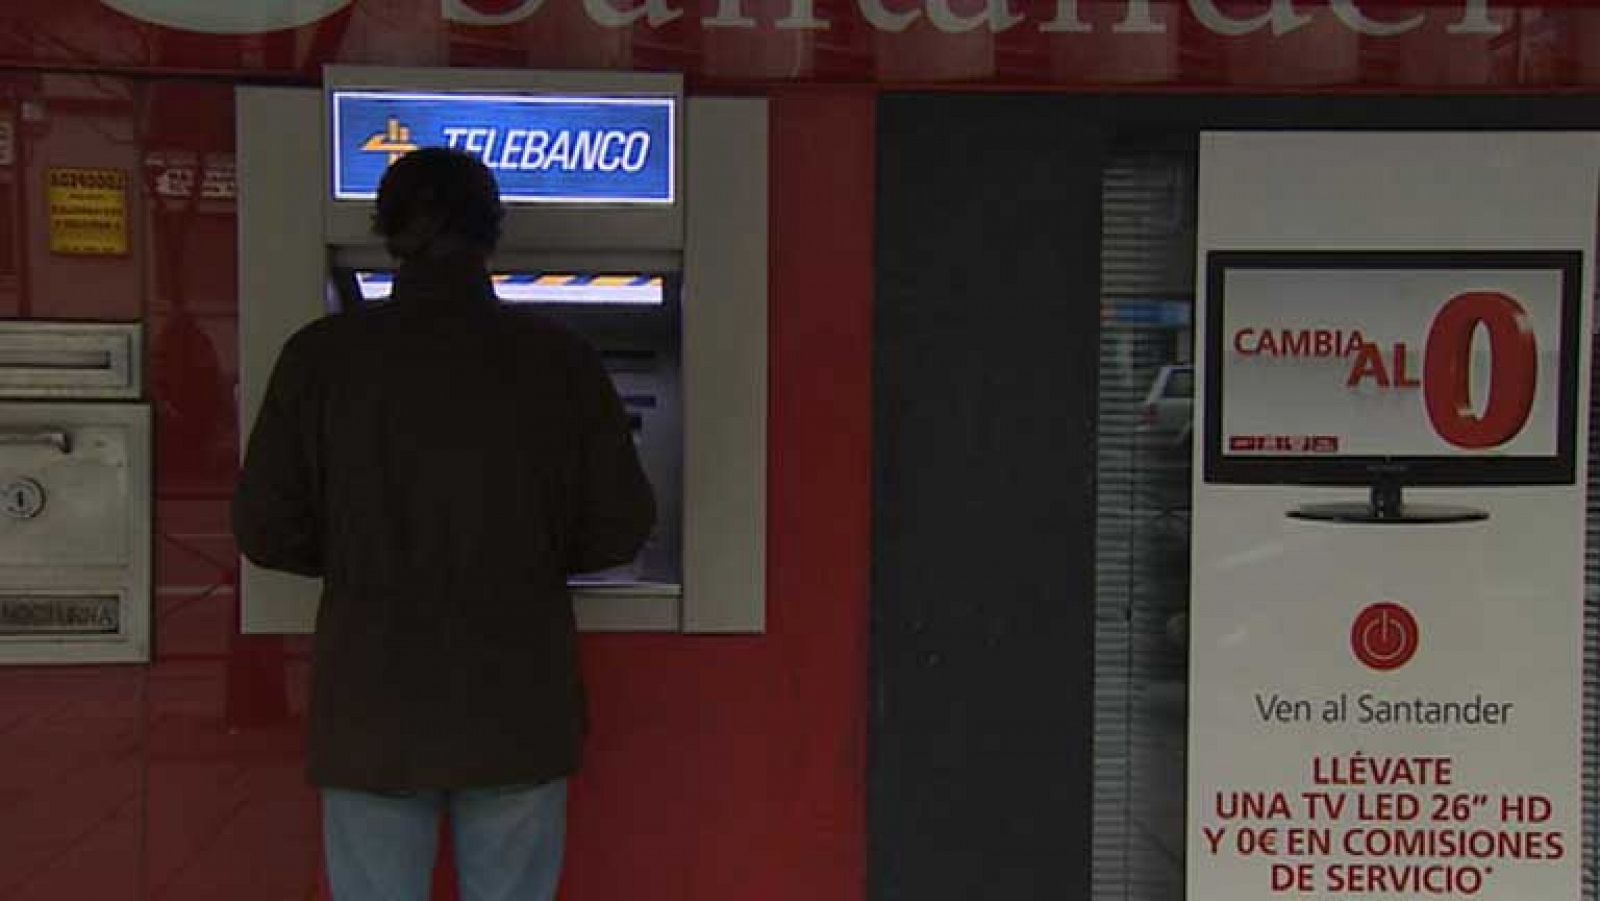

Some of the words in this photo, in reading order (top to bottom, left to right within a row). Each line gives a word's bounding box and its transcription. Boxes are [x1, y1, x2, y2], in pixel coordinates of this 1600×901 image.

[443, 126, 651, 173] TELEBANCO
[1234, 329, 1365, 357] CAMBIA
[1347, 343, 1421, 388] AL
[1424, 291, 1538, 449] 0
[1255, 695, 1311, 722] Ven
[1322, 695, 1347, 723] al
[1358, 695, 1512, 724] Santander
[1313, 751, 1452, 785] LLÉVATE
[1216, 793, 1290, 820] UNA
[1303, 793, 1346, 820] TV
[1358, 794, 1419, 820] LED
[1501, 797, 1551, 822] HD
[1203, 828, 1225, 854] Y
[1237, 829, 1277, 855] 0€
[1288, 829, 1330, 855] EN
[1344, 830, 1563, 858] COMISIONES
[1272, 865, 1314, 891] DE
